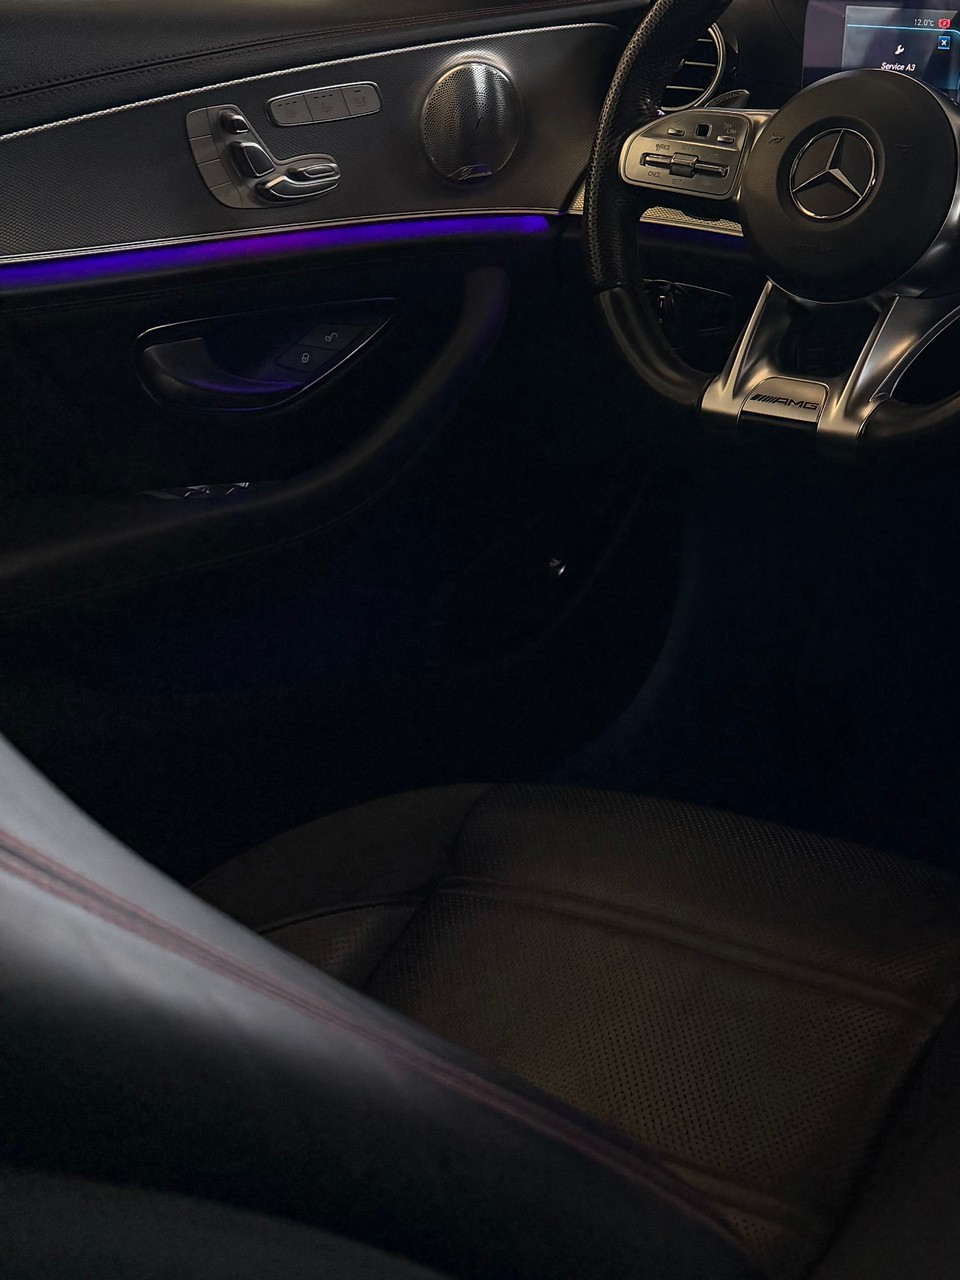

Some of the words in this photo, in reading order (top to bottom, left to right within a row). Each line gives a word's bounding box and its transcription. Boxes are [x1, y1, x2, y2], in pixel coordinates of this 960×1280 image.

[880, 62, 904, 71] Service
[904, 63, 916, 71] A3
[773, 397, 819, 410] AMG
